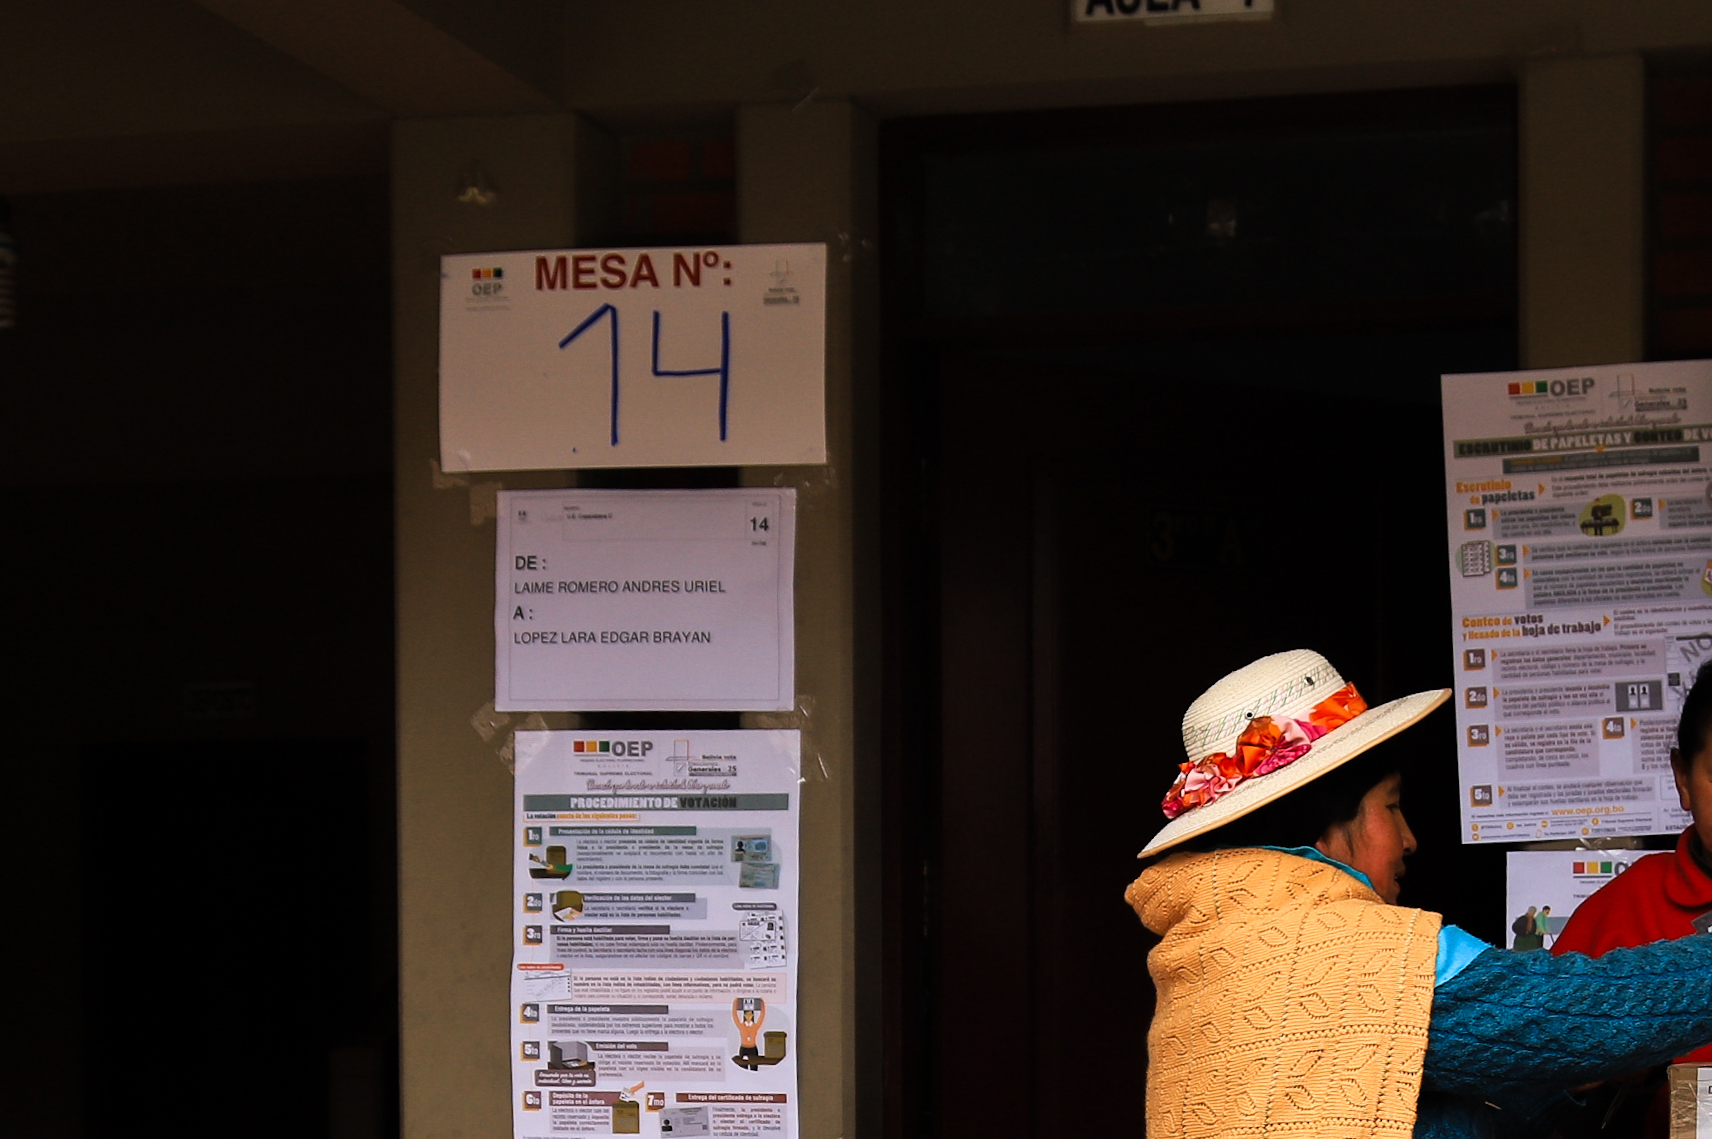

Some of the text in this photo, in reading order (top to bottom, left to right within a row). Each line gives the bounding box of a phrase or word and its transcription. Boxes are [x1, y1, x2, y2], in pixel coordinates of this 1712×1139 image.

[535, 252, 659, 290] MESA
[557, 302, 730, 447] 14
[1550, 377, 1596, 397] OEP
[1550, 433, 1621, 450] PAPELETAS
[1481, 490, 1535, 506] papeletas
[749, 516, 770, 532] 14
[514, 554, 538, 571] DE
[514, 578, 727, 594] LAIME ROMERO ANDRES URIEL
[513, 606, 525, 620] A
[1514, 614, 1544, 625] votos
[1522, 624, 1545, 637] hoja
[1547, 623, 1560, 635] de
[1562, 620, 1602, 635] trabajo
[513, 630, 712, 645] LOPEZ LARA EDGAR BRAYAN
[611, 740, 653, 757] OEP
[570, 794, 737, 809] PROCEDIMIENTO DE VOTACIÓN
[1550, 805, 1625, 816] www.oep.org.bo
